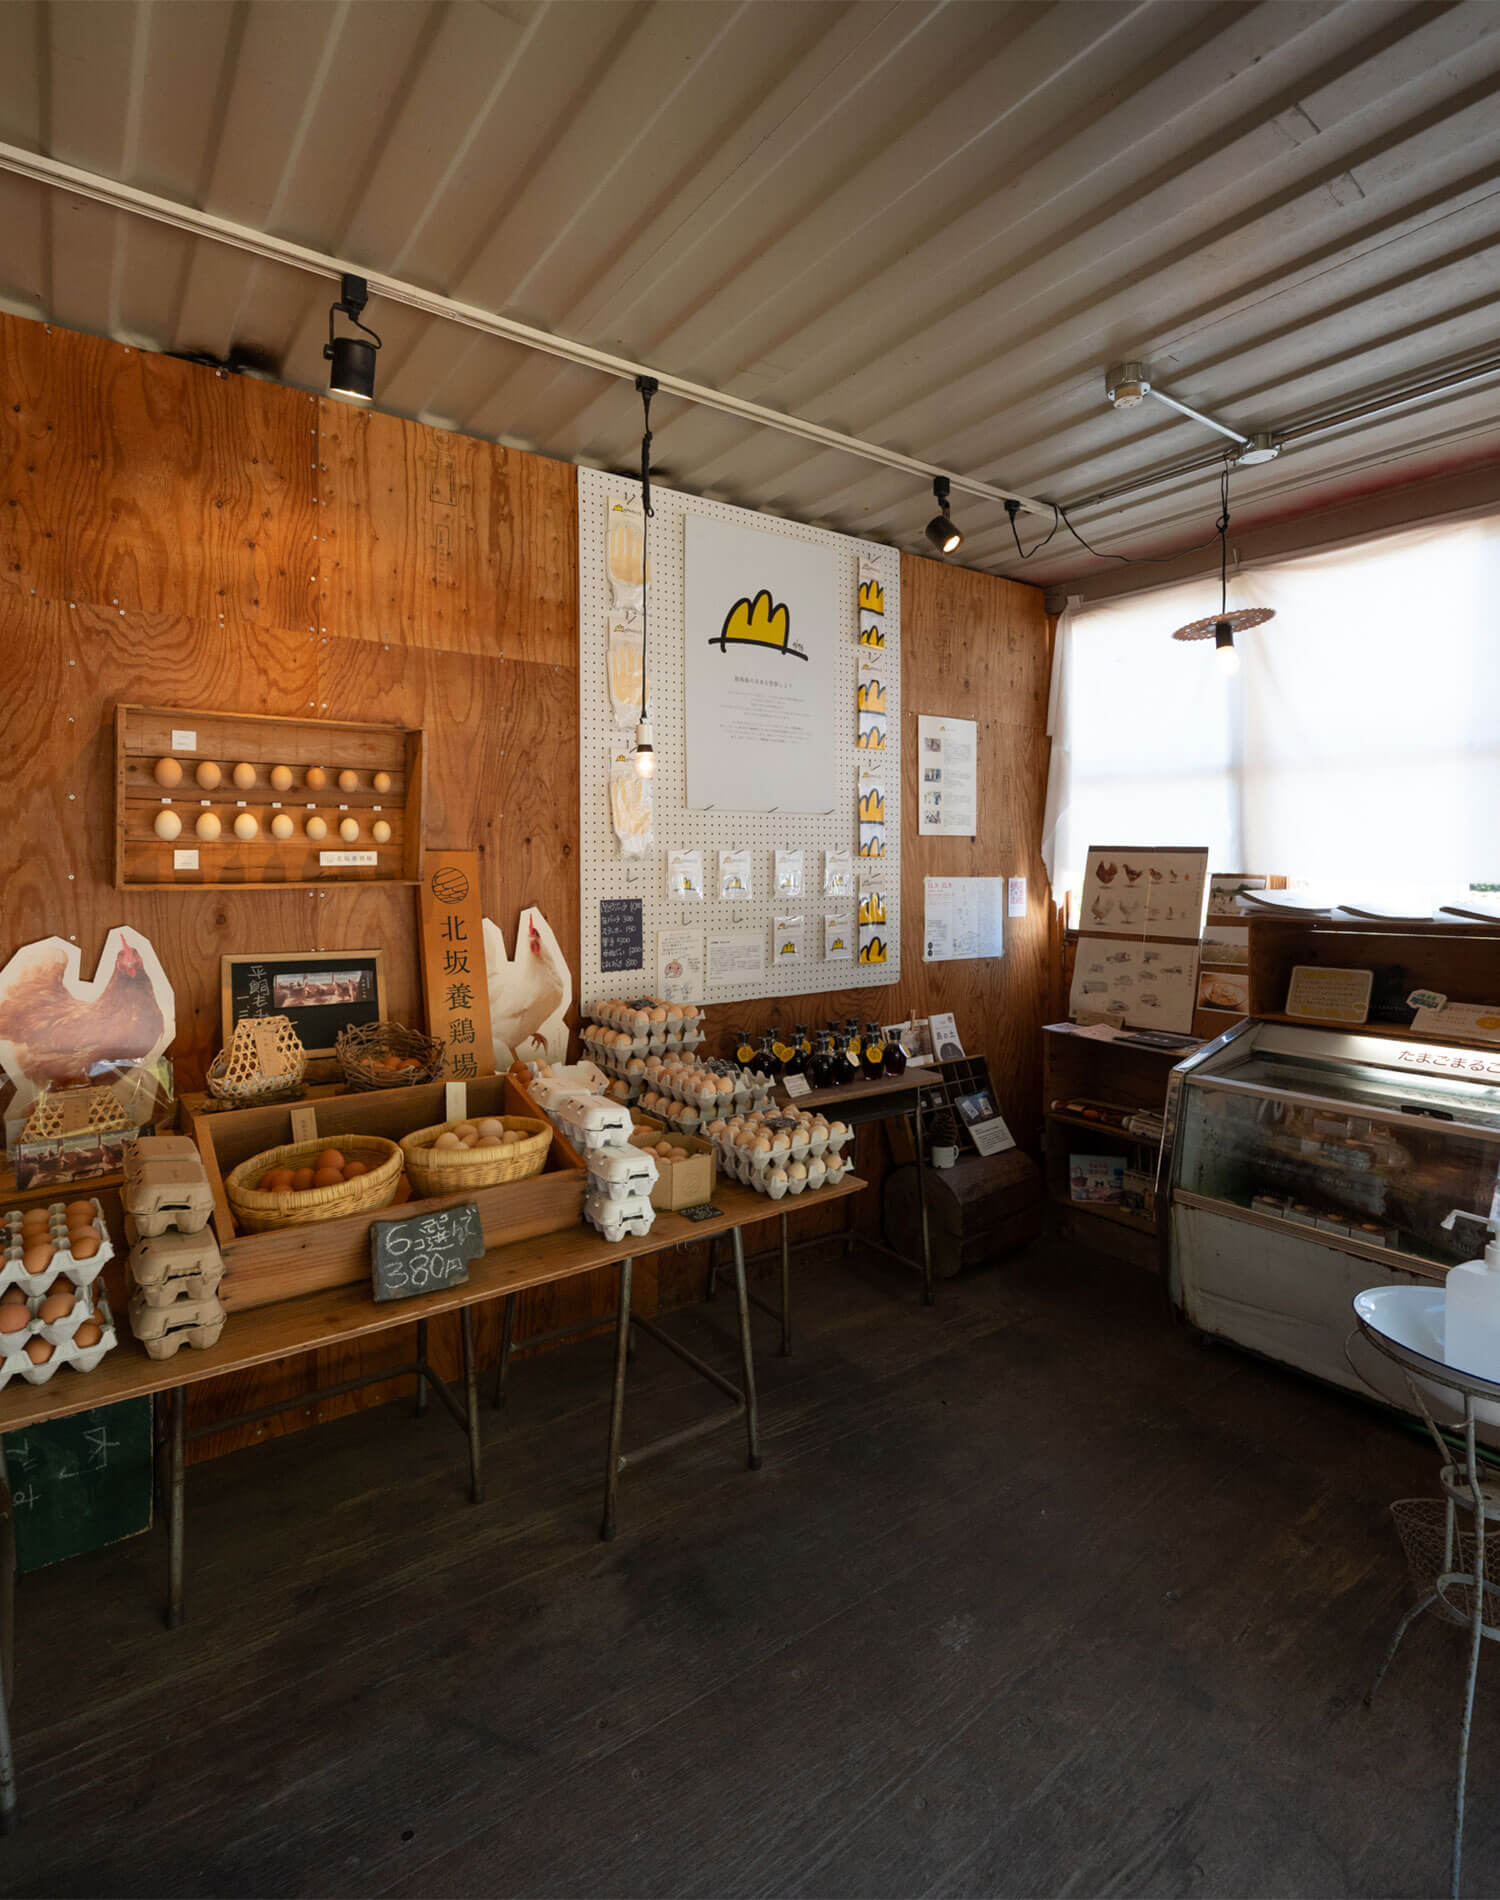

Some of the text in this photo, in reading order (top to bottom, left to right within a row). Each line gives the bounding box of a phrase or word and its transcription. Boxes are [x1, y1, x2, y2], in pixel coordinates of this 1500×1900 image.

[440, 915, 478, 1080] 北坂養鶏場
[384, 1253, 463, 1289] 380円
